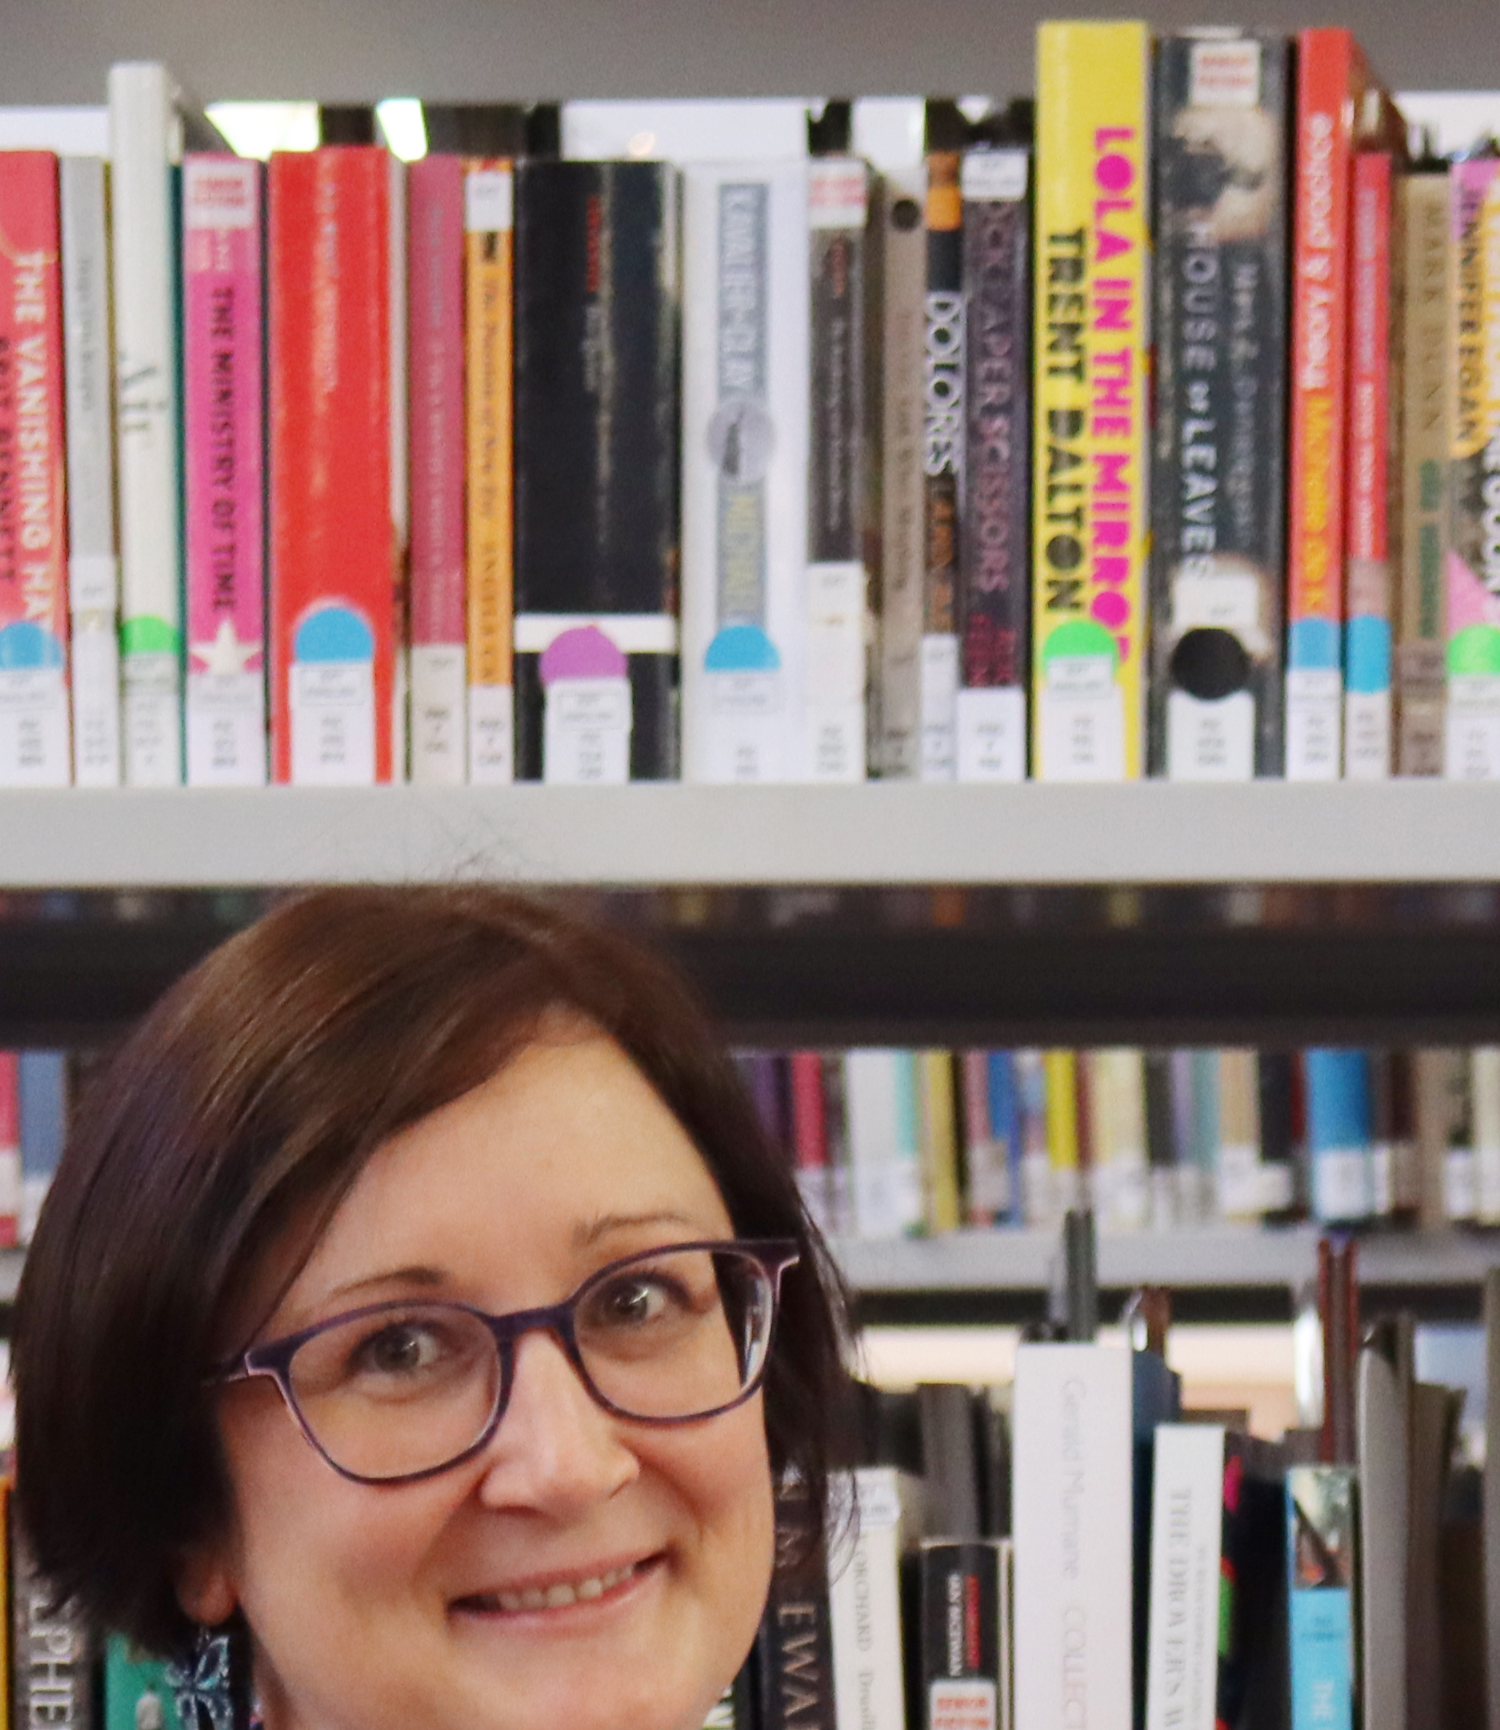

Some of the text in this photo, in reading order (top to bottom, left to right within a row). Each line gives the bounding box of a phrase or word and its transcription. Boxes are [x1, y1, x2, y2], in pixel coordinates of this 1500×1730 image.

[13, 250, 50, 549] THE VANISHING
[209, 286, 237, 613] THE MINISTRY OF TIME
[923, 296, 961, 478] DOLORES
[1045, 227, 1088, 614] TRENT DALTON
[1089, 127, 1136, 665] LOLA IN THE MIRRO
[1182, 223, 1220, 583] HOUSE LEAVES
[1061, 1378, 1089, 1463] Gerald
[1062, 1468, 1086, 1581] Murnane
[1166, 1487, 1194, 1547] THE
[1314, 1680, 1336, 1718] THE
